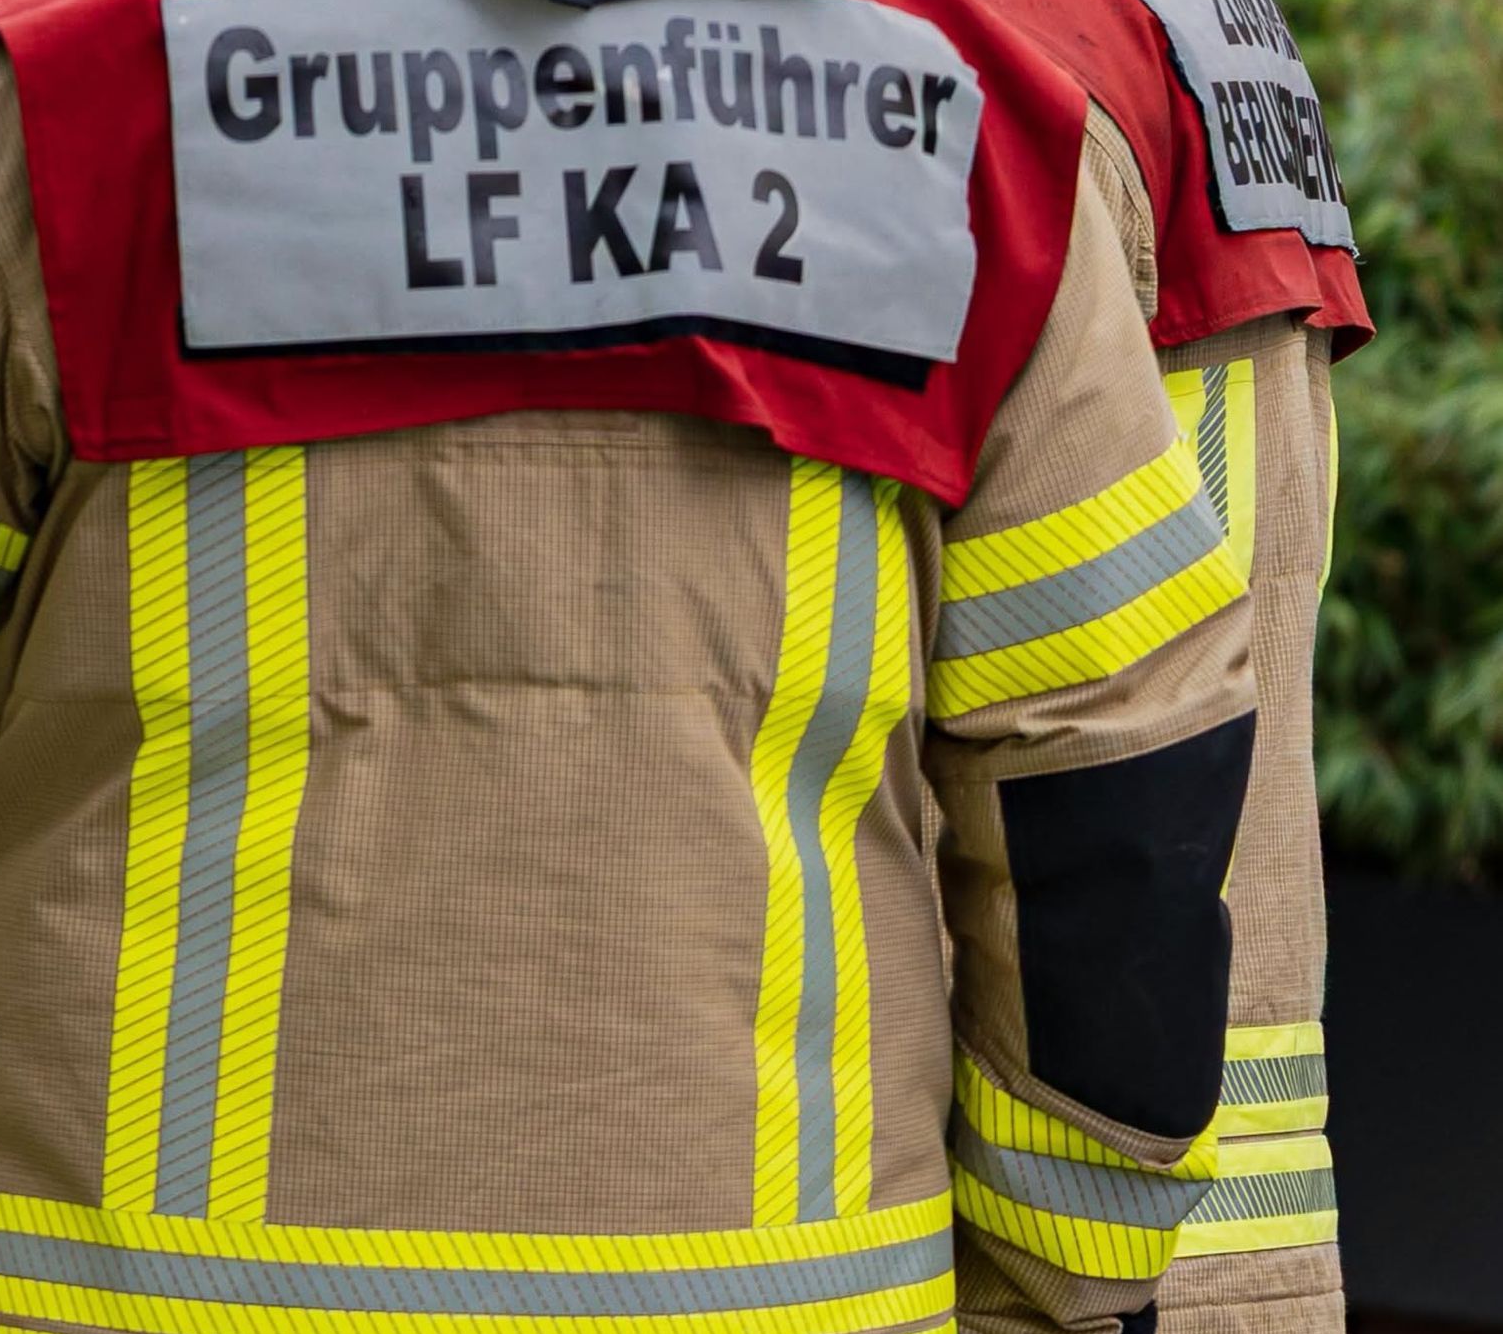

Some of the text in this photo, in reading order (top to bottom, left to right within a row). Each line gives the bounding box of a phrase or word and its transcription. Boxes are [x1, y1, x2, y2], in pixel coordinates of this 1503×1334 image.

[205, 17, 957, 163] Gruppenführer
[400, 161, 804, 290] LF KA 2
